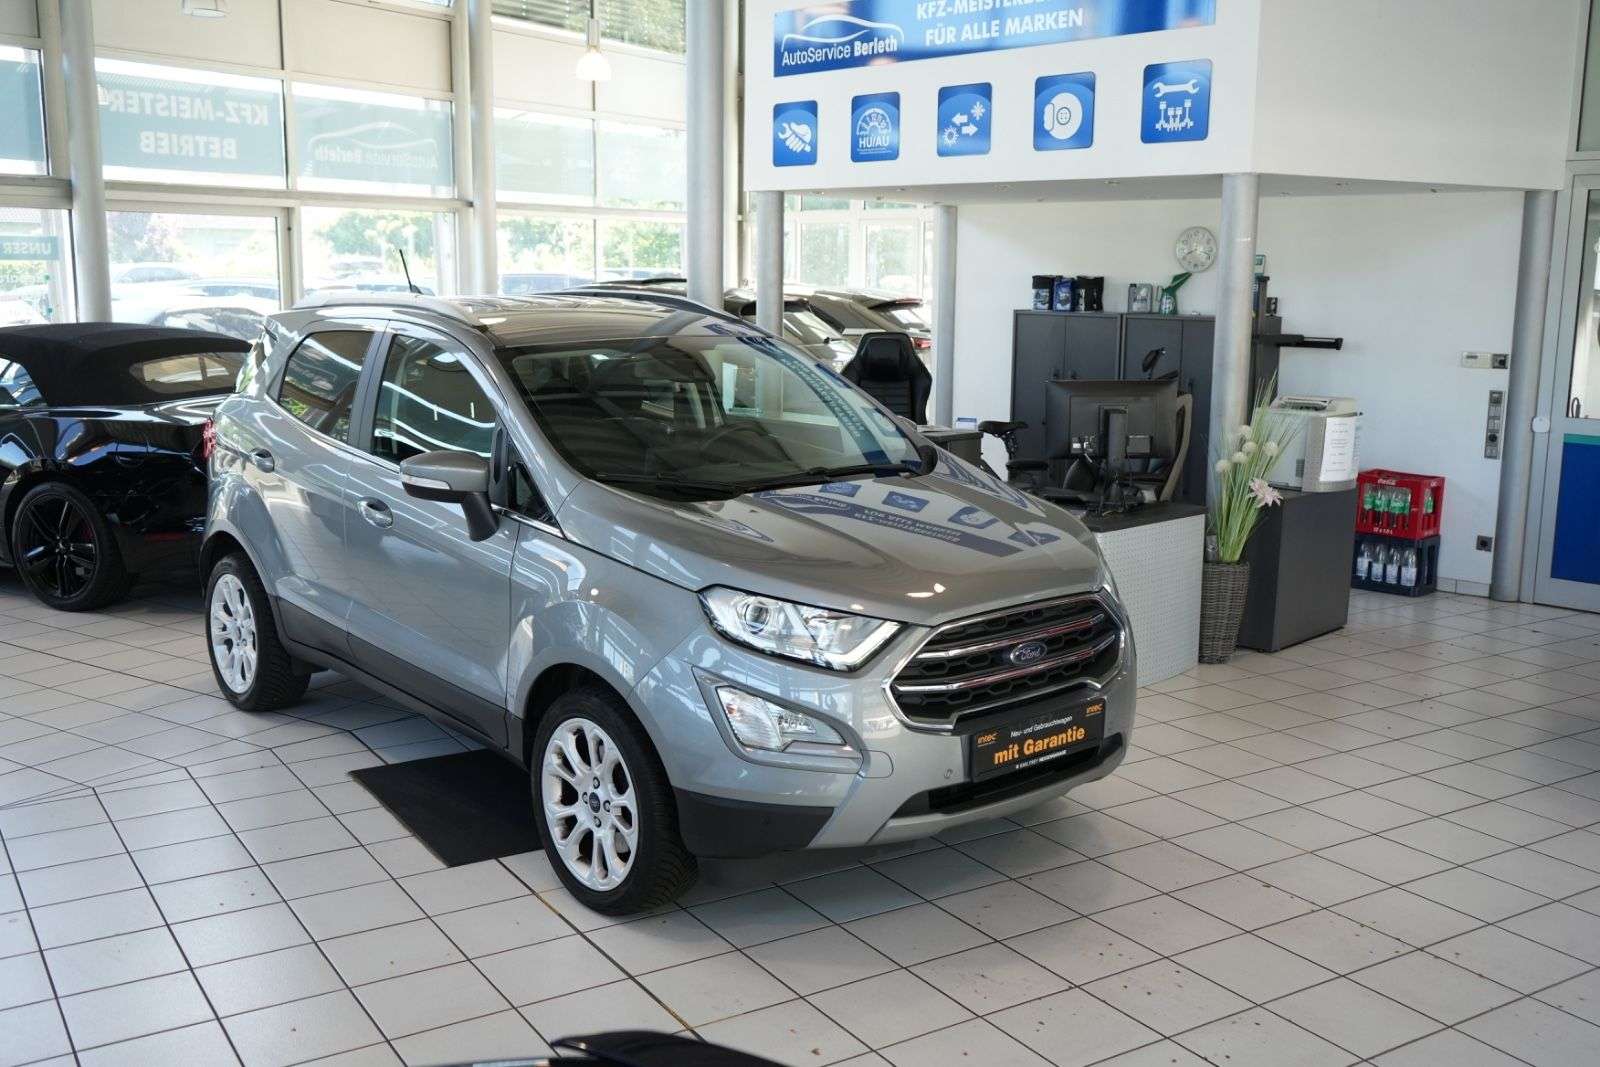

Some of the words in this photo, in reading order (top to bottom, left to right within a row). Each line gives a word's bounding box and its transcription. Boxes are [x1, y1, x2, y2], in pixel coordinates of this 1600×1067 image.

[916, 0, 1045, 20] KFZ-MEIST
[925, 23, 957, 46] FÜR
[961, 20, 1000, 42] ALLE
[1005, 8, 1083, 36] MARKEN
[782, 43, 851, 66] AutoService
[854, 35, 898, 57] Berleth
[858, 135, 890, 148] HU/AU
[1023, 725, 1033, 734] und
[994, 744, 1019, 764] mit
[1023, 726, 1085, 756] Garantie
